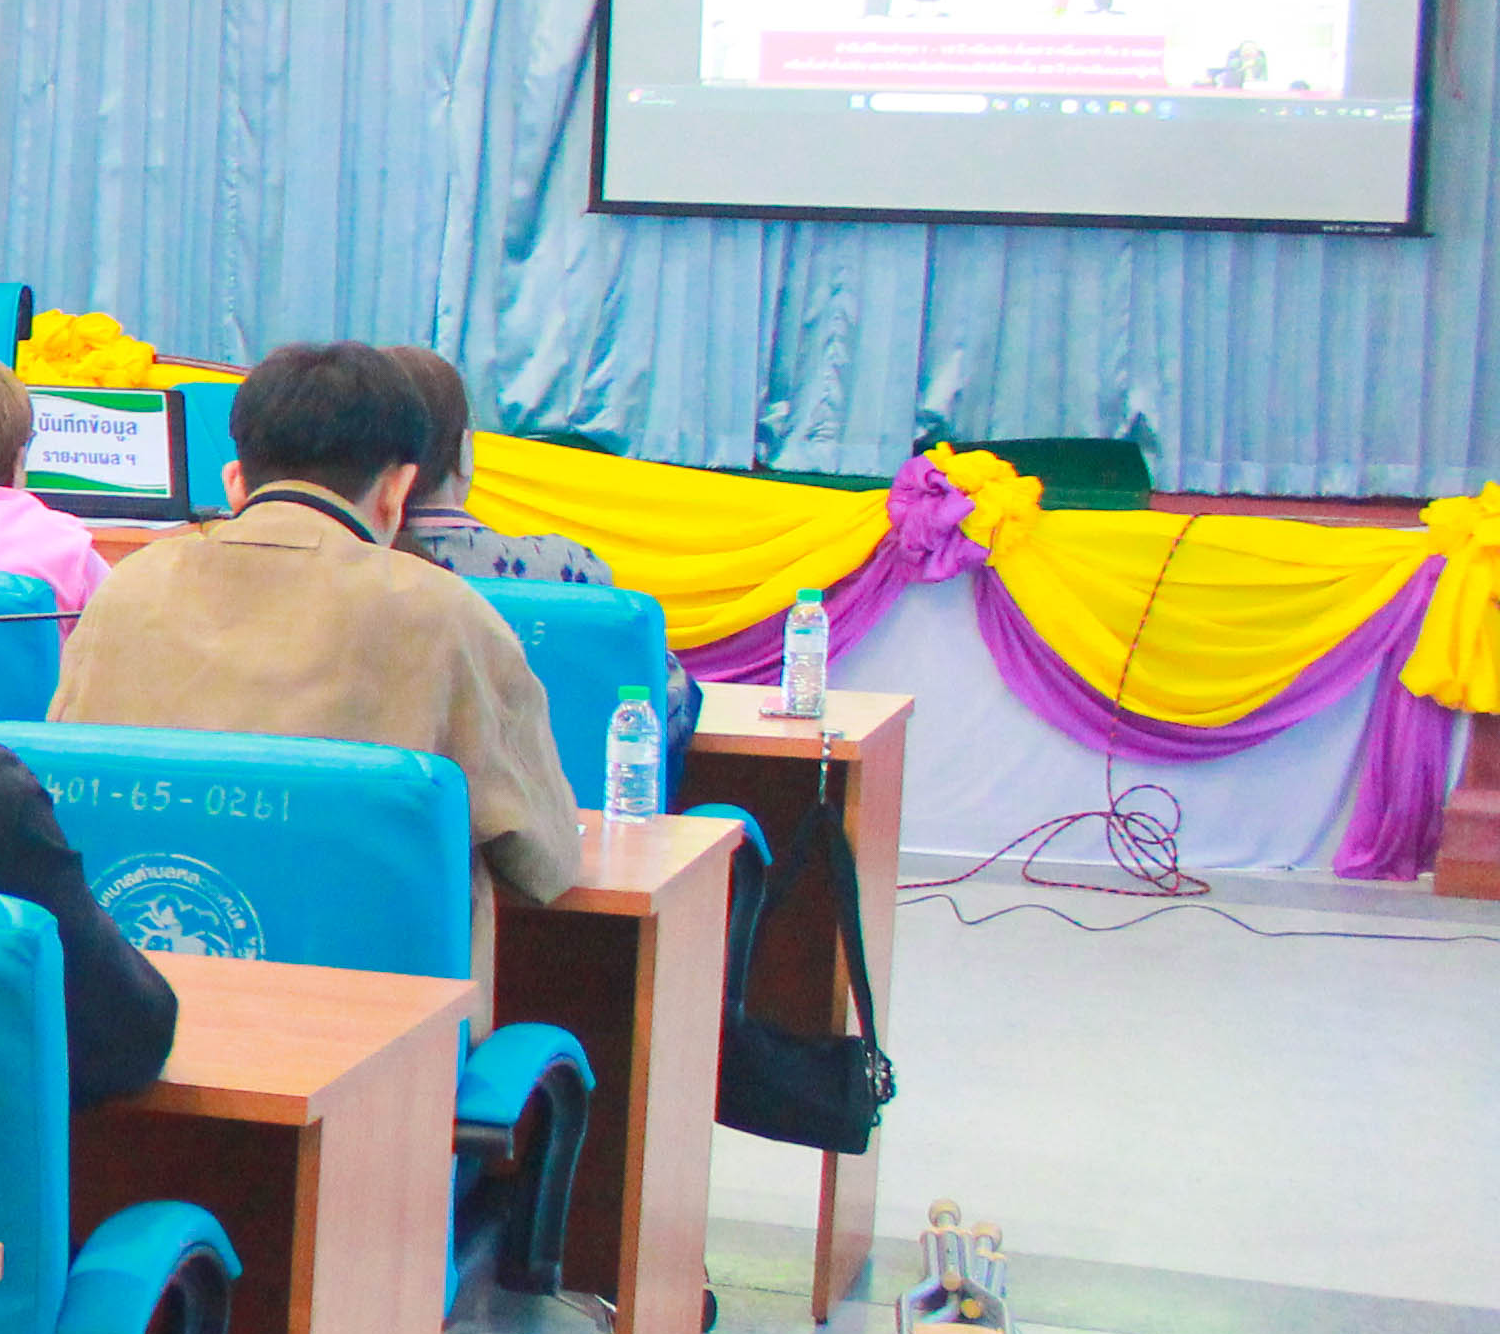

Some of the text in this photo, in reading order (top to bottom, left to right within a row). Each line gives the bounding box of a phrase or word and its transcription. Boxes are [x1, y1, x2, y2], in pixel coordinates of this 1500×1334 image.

[37, 411, 138, 442] บันทึกข้อมูล
